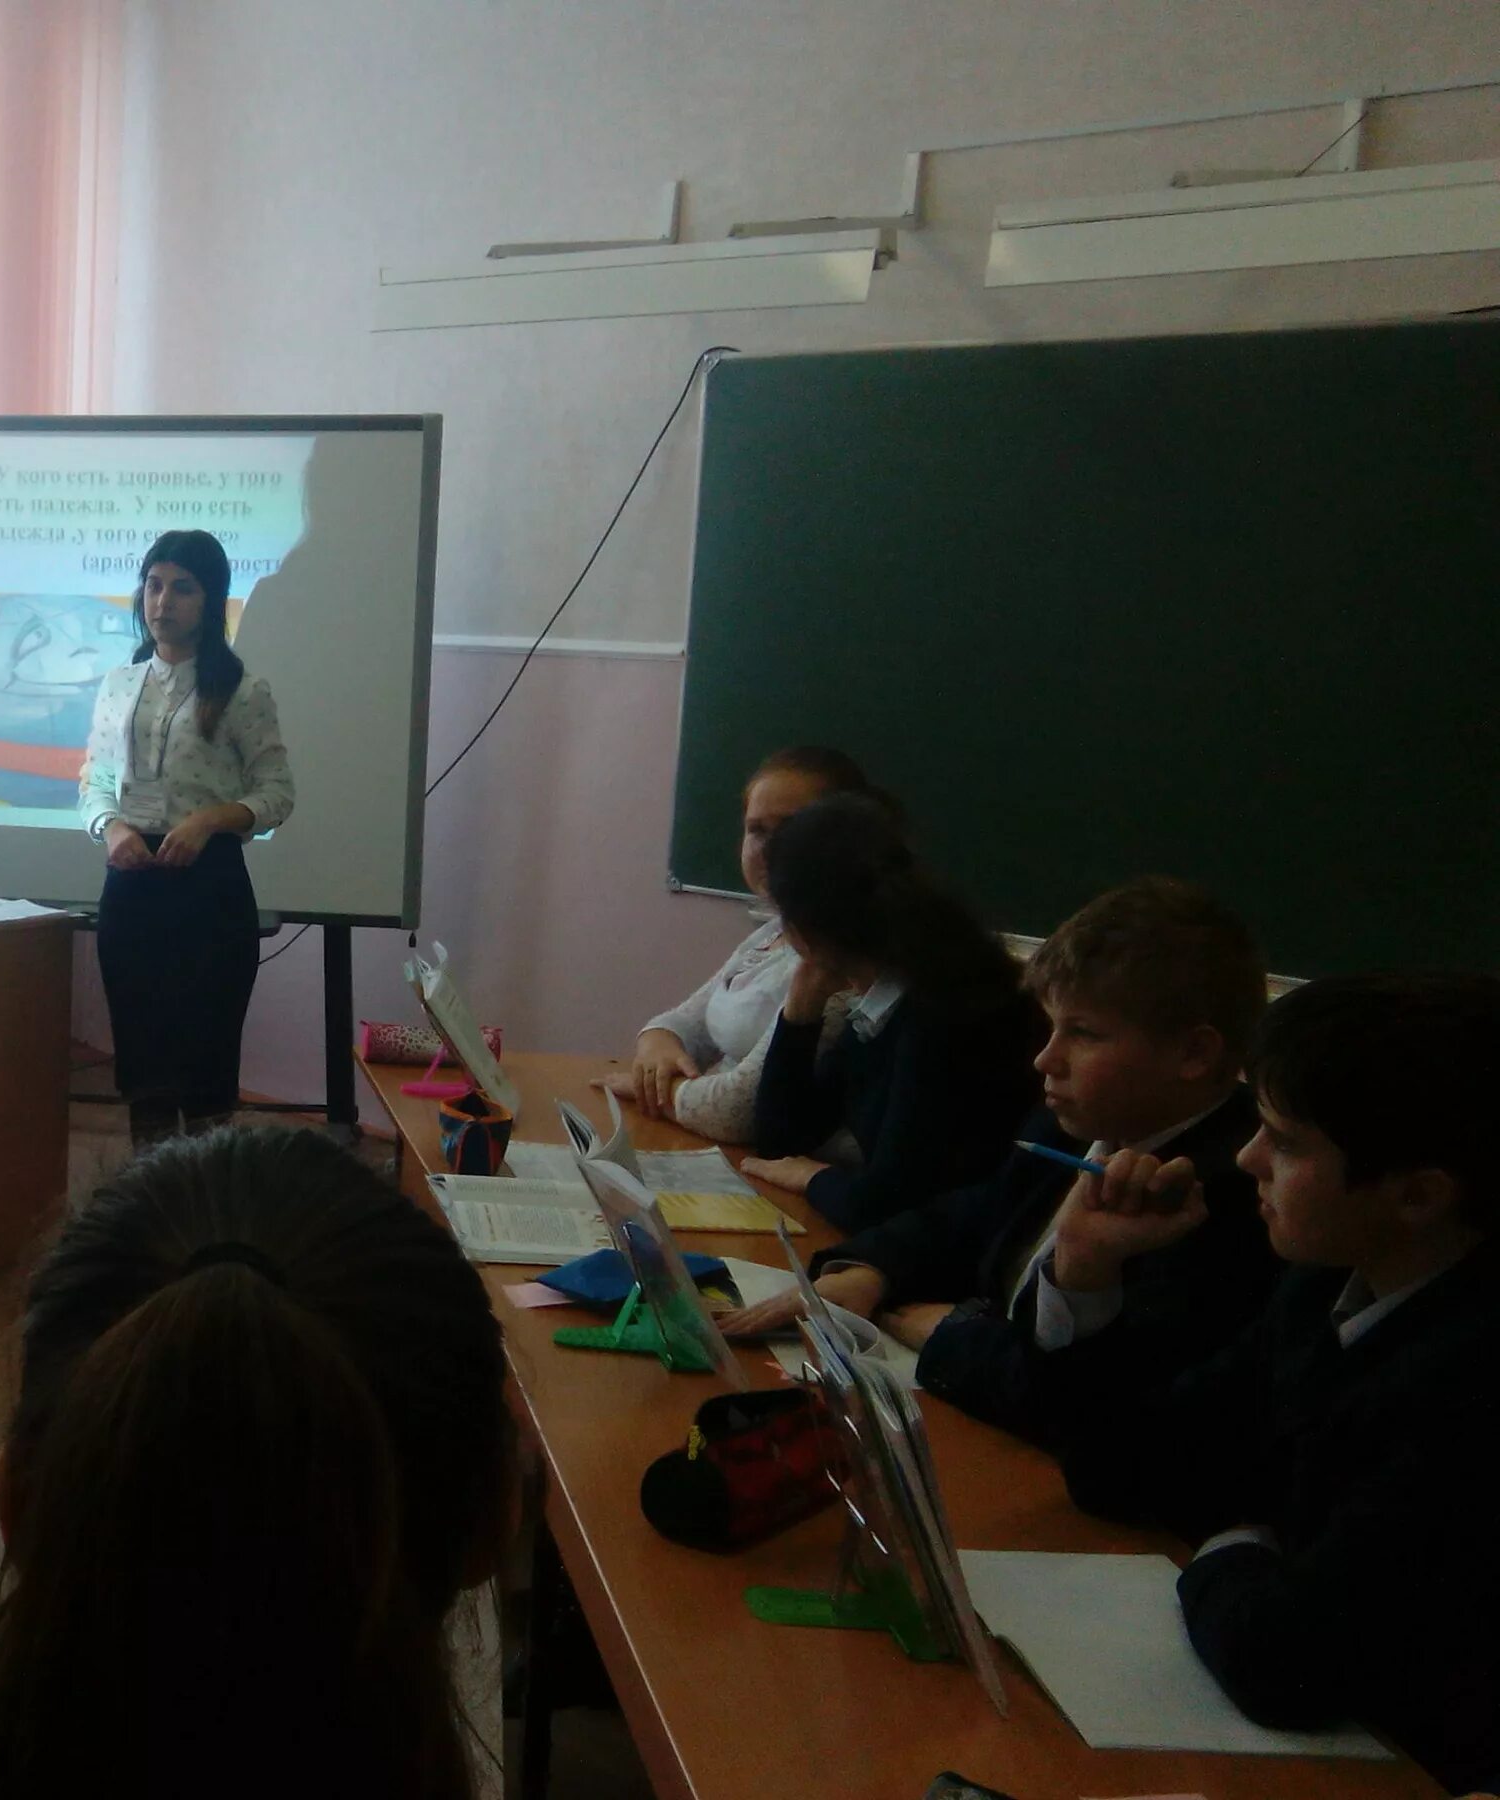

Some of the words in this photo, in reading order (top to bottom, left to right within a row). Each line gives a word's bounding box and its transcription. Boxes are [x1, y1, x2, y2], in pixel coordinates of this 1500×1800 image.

[17, 470, 62, 487] кого
[66, 470, 110, 487] есть
[219, 471, 230, 490] у
[236, 471, 282, 487] того
[135, 495, 150, 514] У
[156, 500, 202, 516] кого
[208, 500, 253, 517] есть
[95, 527, 138, 544] того
